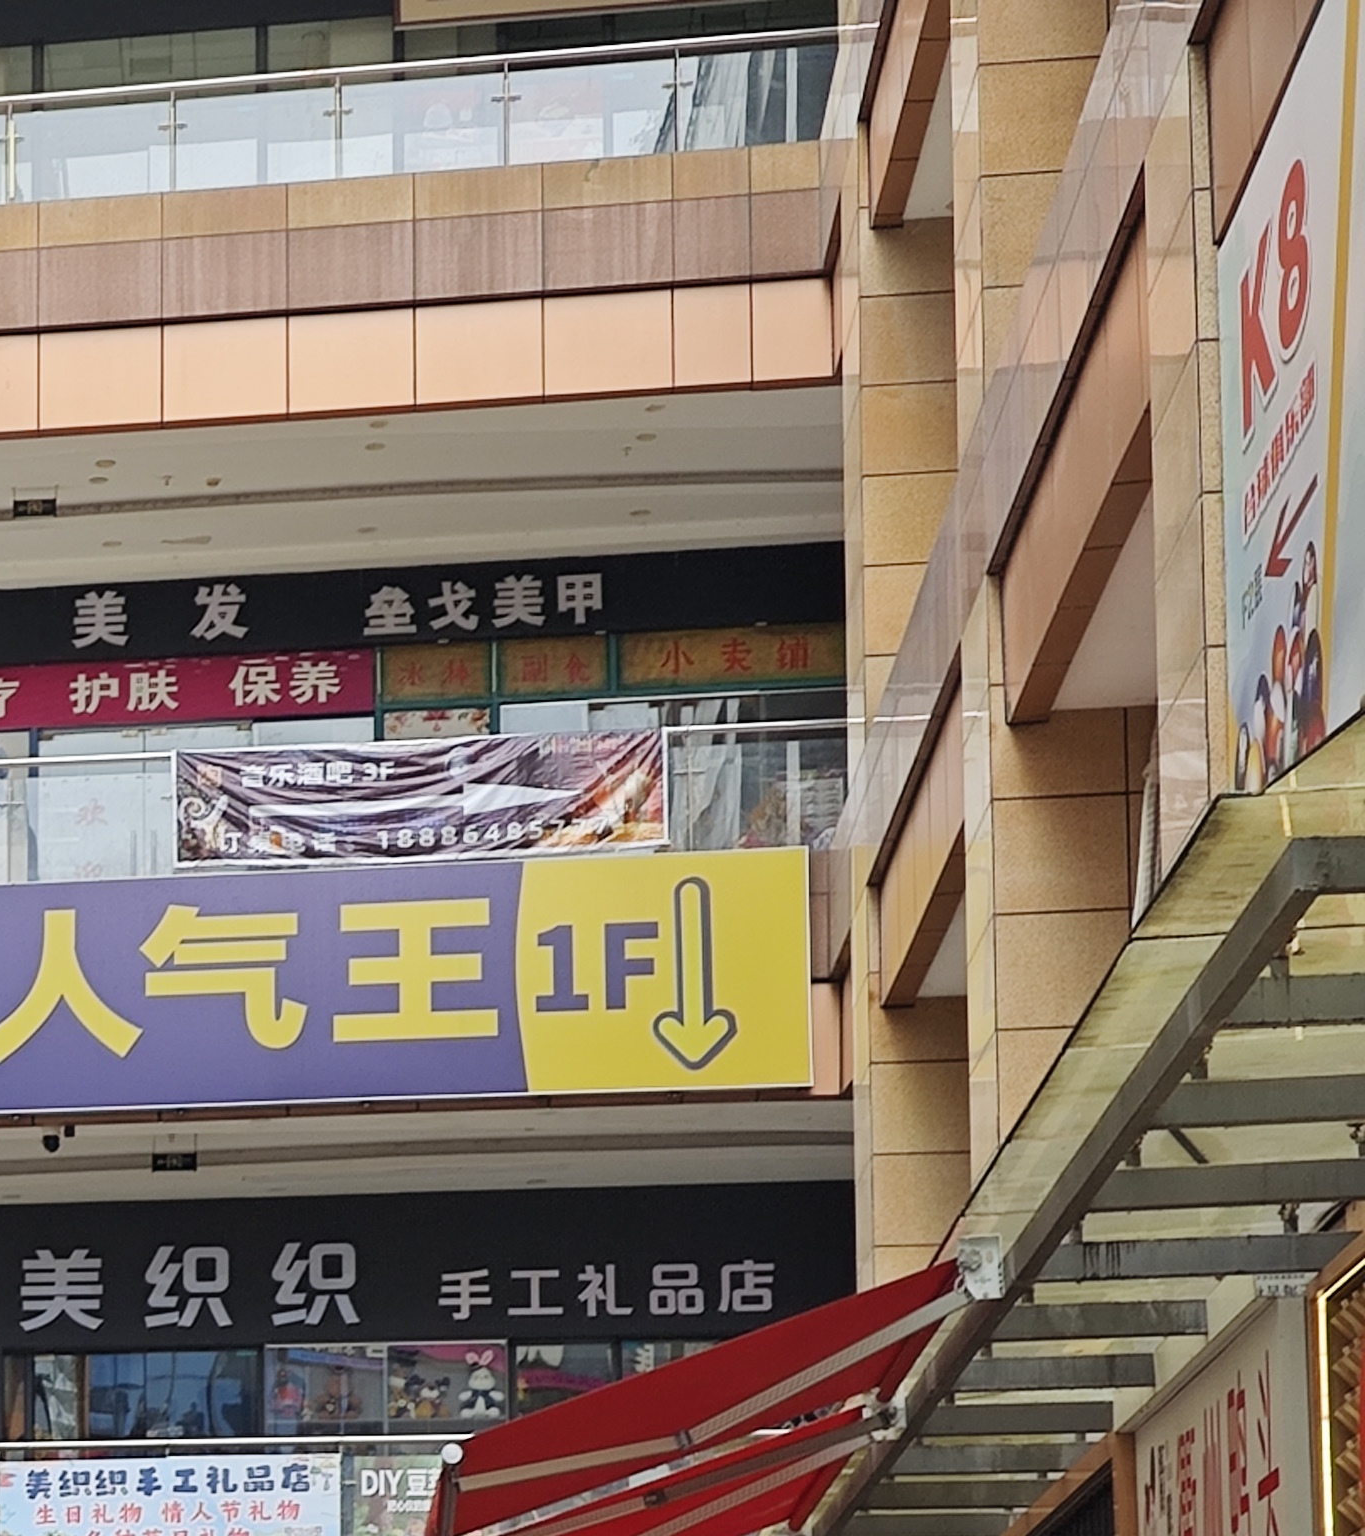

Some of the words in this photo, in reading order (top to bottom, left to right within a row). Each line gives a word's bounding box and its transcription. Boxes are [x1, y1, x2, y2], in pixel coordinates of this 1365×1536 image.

[1239, 158, 1313, 436] K8
[72, 582, 250, 650] 美发
[69, 669, 179, 715] 护肤
[229, 660, 343, 709] 保养
[240, 763, 355, 789] 音乐酒吧
[534, 919, 659, 1014] 1F
[19, 1242, 361, 1333] 美织织
[437, 1259, 777, 1321] 手工礼品店
[25, 1463, 311, 1500] 美织织手工礼品店
[361, 1467, 399, 1497] DIY
[35, 1504, 143, 1525] 生日礼物
[160, 1500, 301, 1524] 情人节礼物
